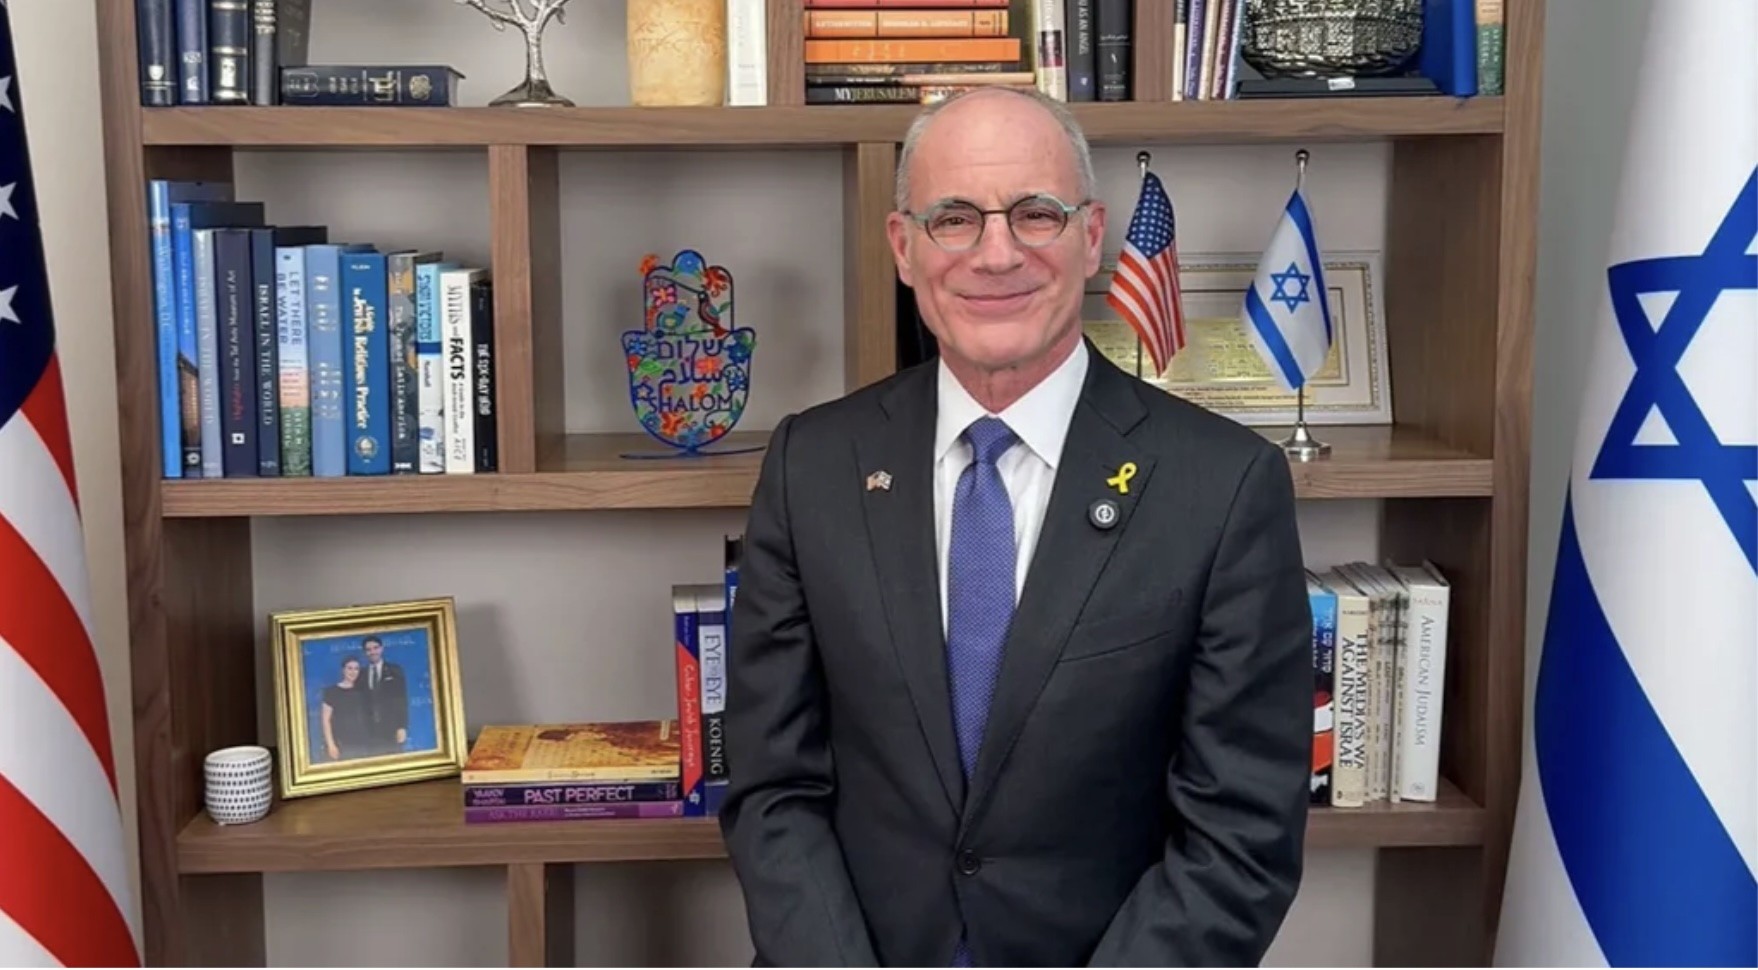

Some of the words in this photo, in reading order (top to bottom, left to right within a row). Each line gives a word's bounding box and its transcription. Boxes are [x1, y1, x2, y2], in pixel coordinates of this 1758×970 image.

[277, 273, 288, 288] BE
[289, 271, 301, 296] LET
[258, 284, 270, 330] ISRAEL
[278, 296, 289, 344] WATER
[291, 301, 303, 346] THERE
[259, 333, 270, 347] IN
[658, 335, 723, 360] שלום
[260, 350, 272, 377] THE
[450, 338, 466, 380] FACTS
[262, 380, 273, 426] WORLD
[355, 387, 370, 429] Practice
[648, 393, 732, 414] SHALOM
[704, 633, 722, 664] EYE
[1356, 633, 1369, 668] THE
[1418, 616, 1435, 686] AMERICAN
[705, 677, 723, 705] EYE
[1341, 637, 1355, 716] AGAINST
[709, 718, 724, 775] KOENIG
[523, 788, 562, 804] PAST
[564, 785, 635, 802] PERFECT
